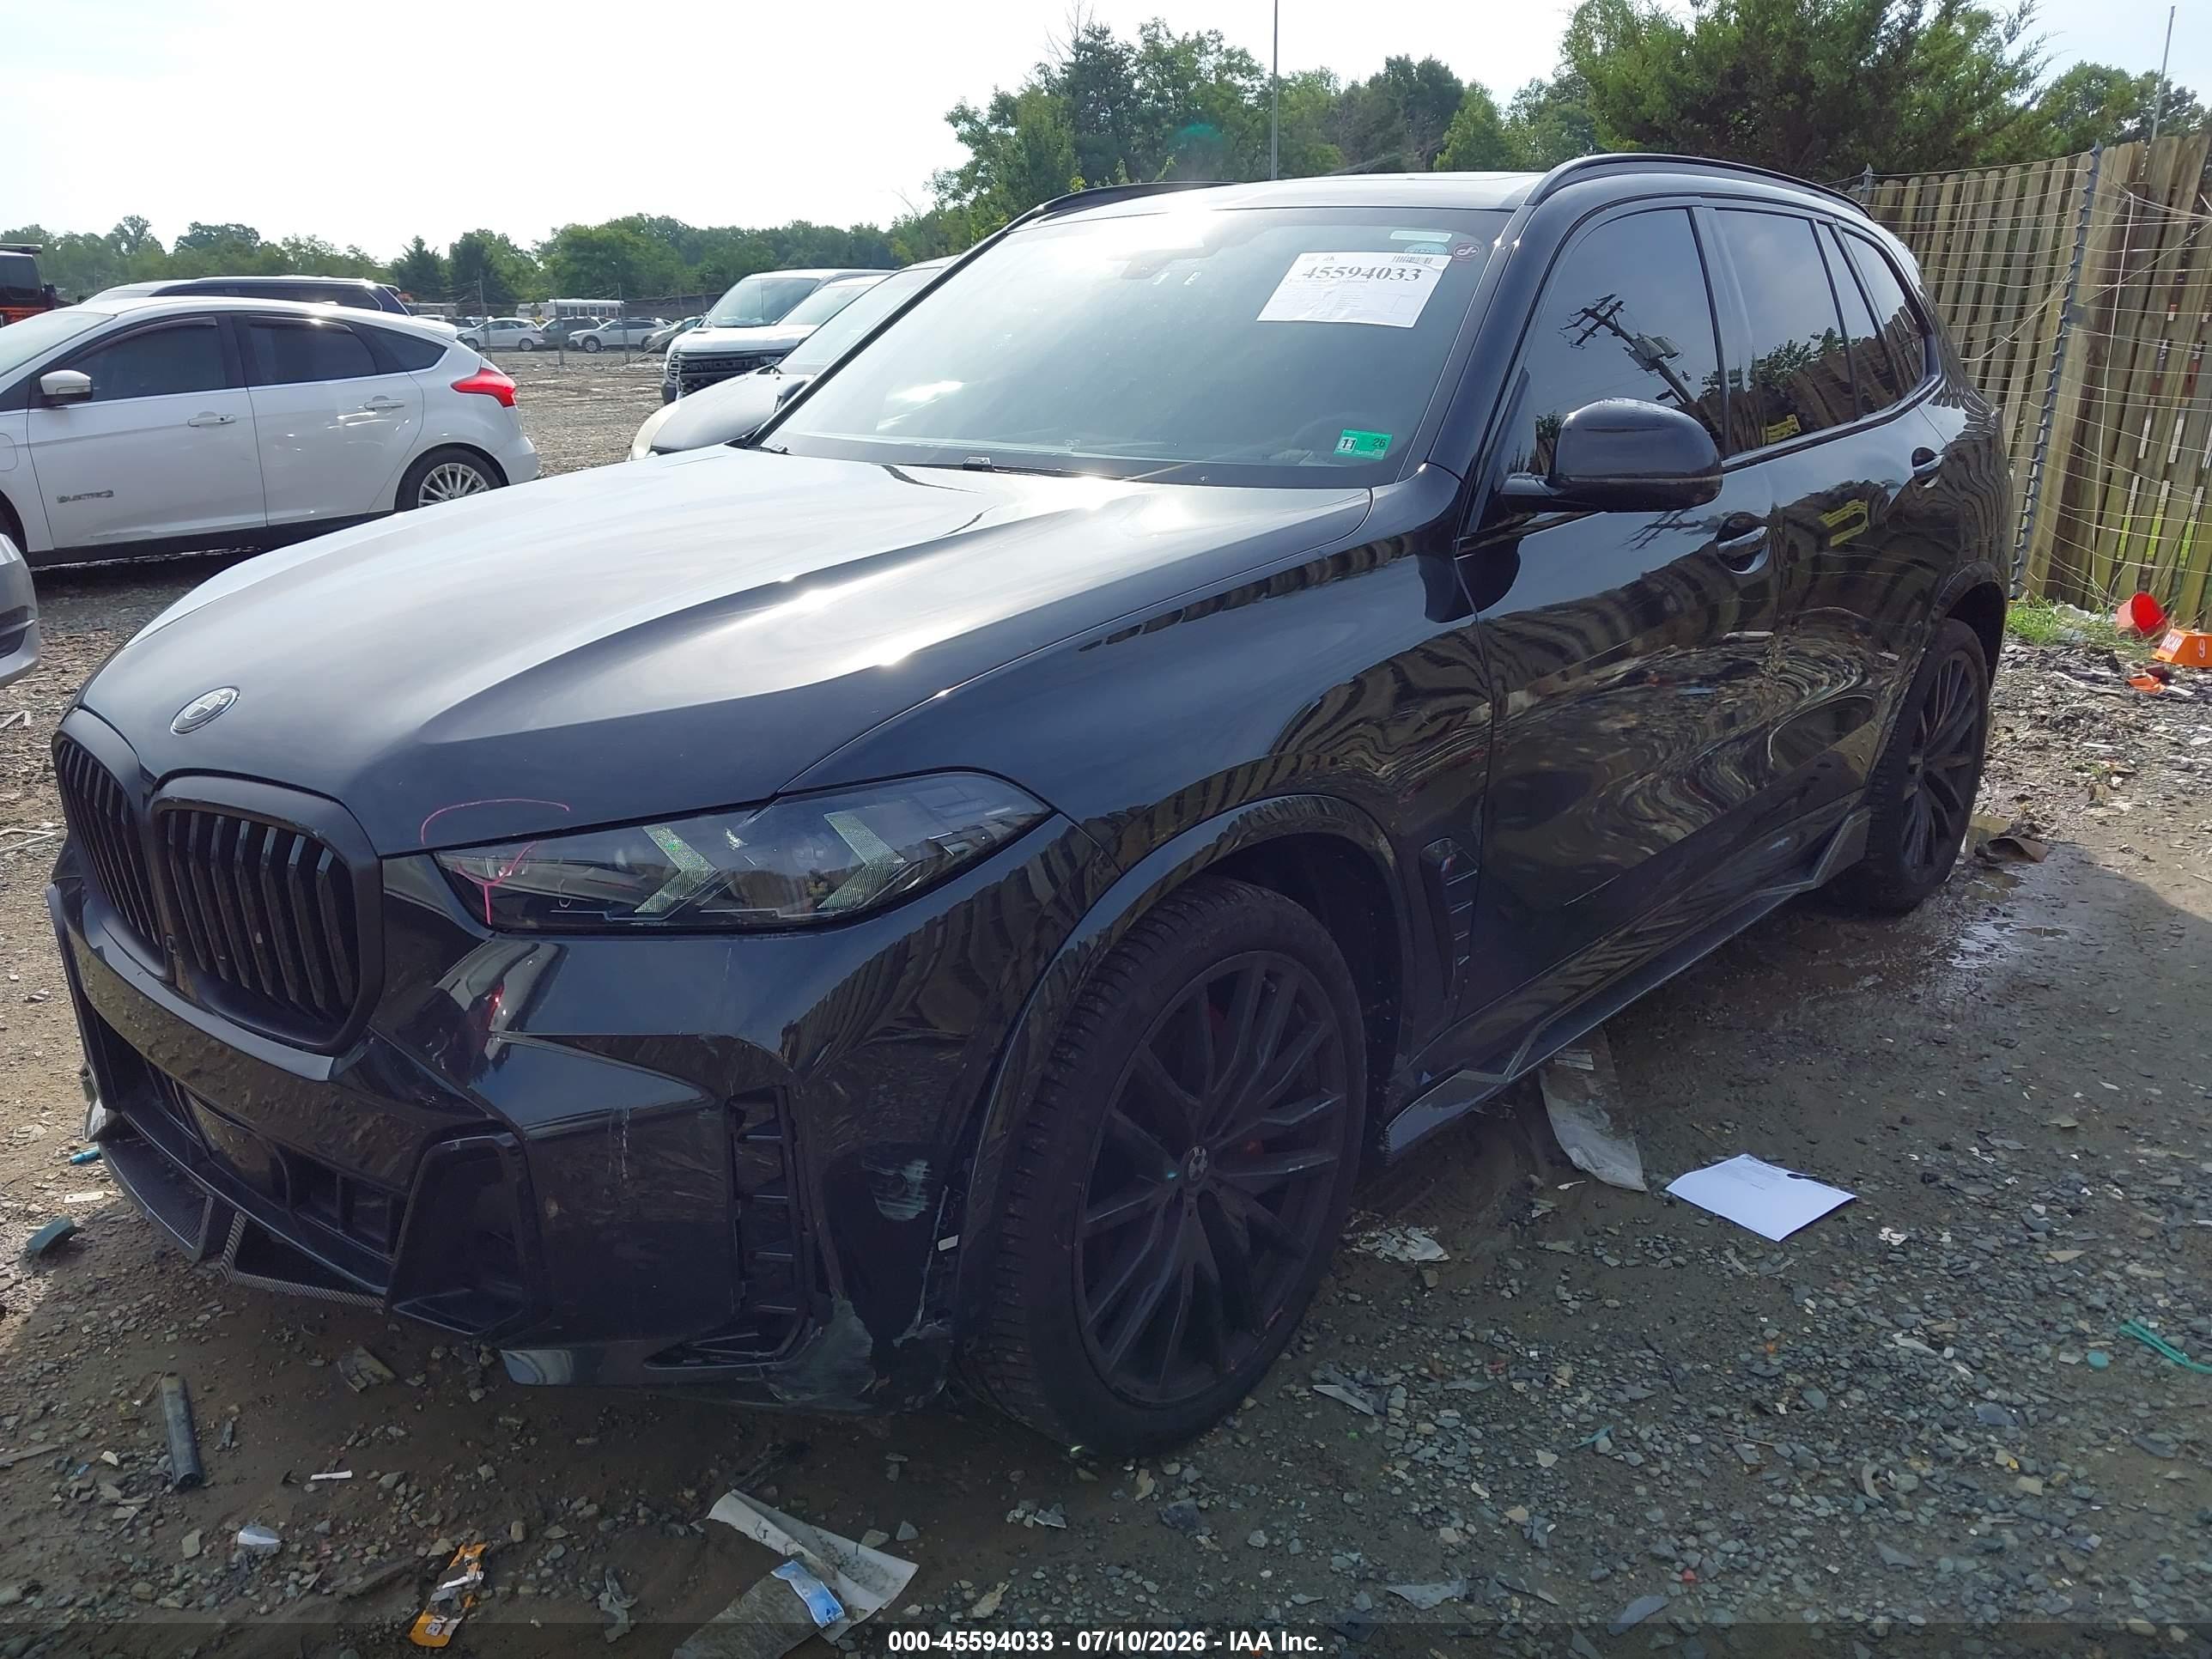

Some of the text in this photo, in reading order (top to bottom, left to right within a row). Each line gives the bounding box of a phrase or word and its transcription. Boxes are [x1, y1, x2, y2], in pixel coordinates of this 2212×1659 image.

[1302, 265, 1422, 282] 45594033
[1342, 437, 1387, 450] 11 26
[2198, 638, 2206, 659] 9
